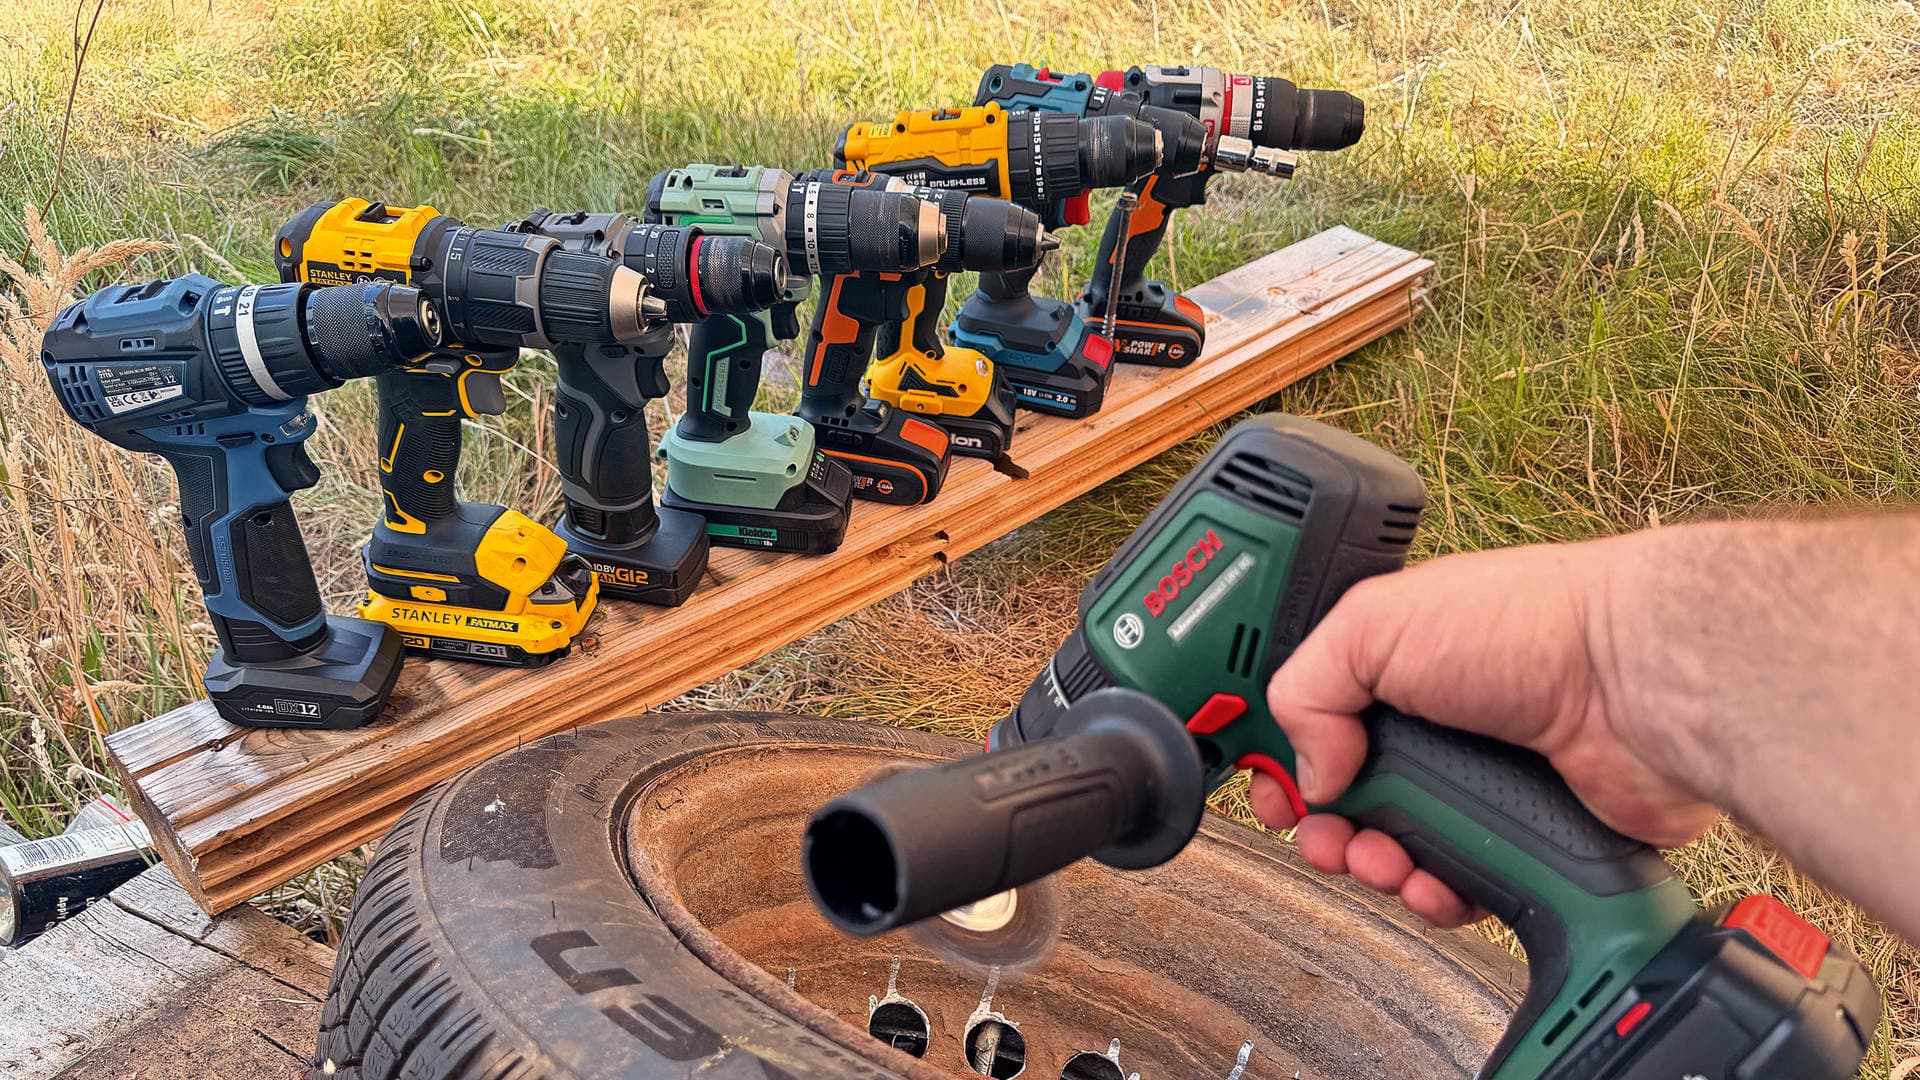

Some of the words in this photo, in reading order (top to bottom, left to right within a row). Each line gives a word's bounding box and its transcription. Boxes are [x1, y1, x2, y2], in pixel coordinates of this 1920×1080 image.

[1253, 120, 1263, 131] 18
[1033, 133, 1042, 144] 15
[1034, 154, 1043, 166] 17
[309, 268, 352, 281] STANLEY
[1143, 528, 1224, 618] BOSCH
[392, 607, 462, 625] STANLEY
[469, 618, 515, 631] FATMAX
